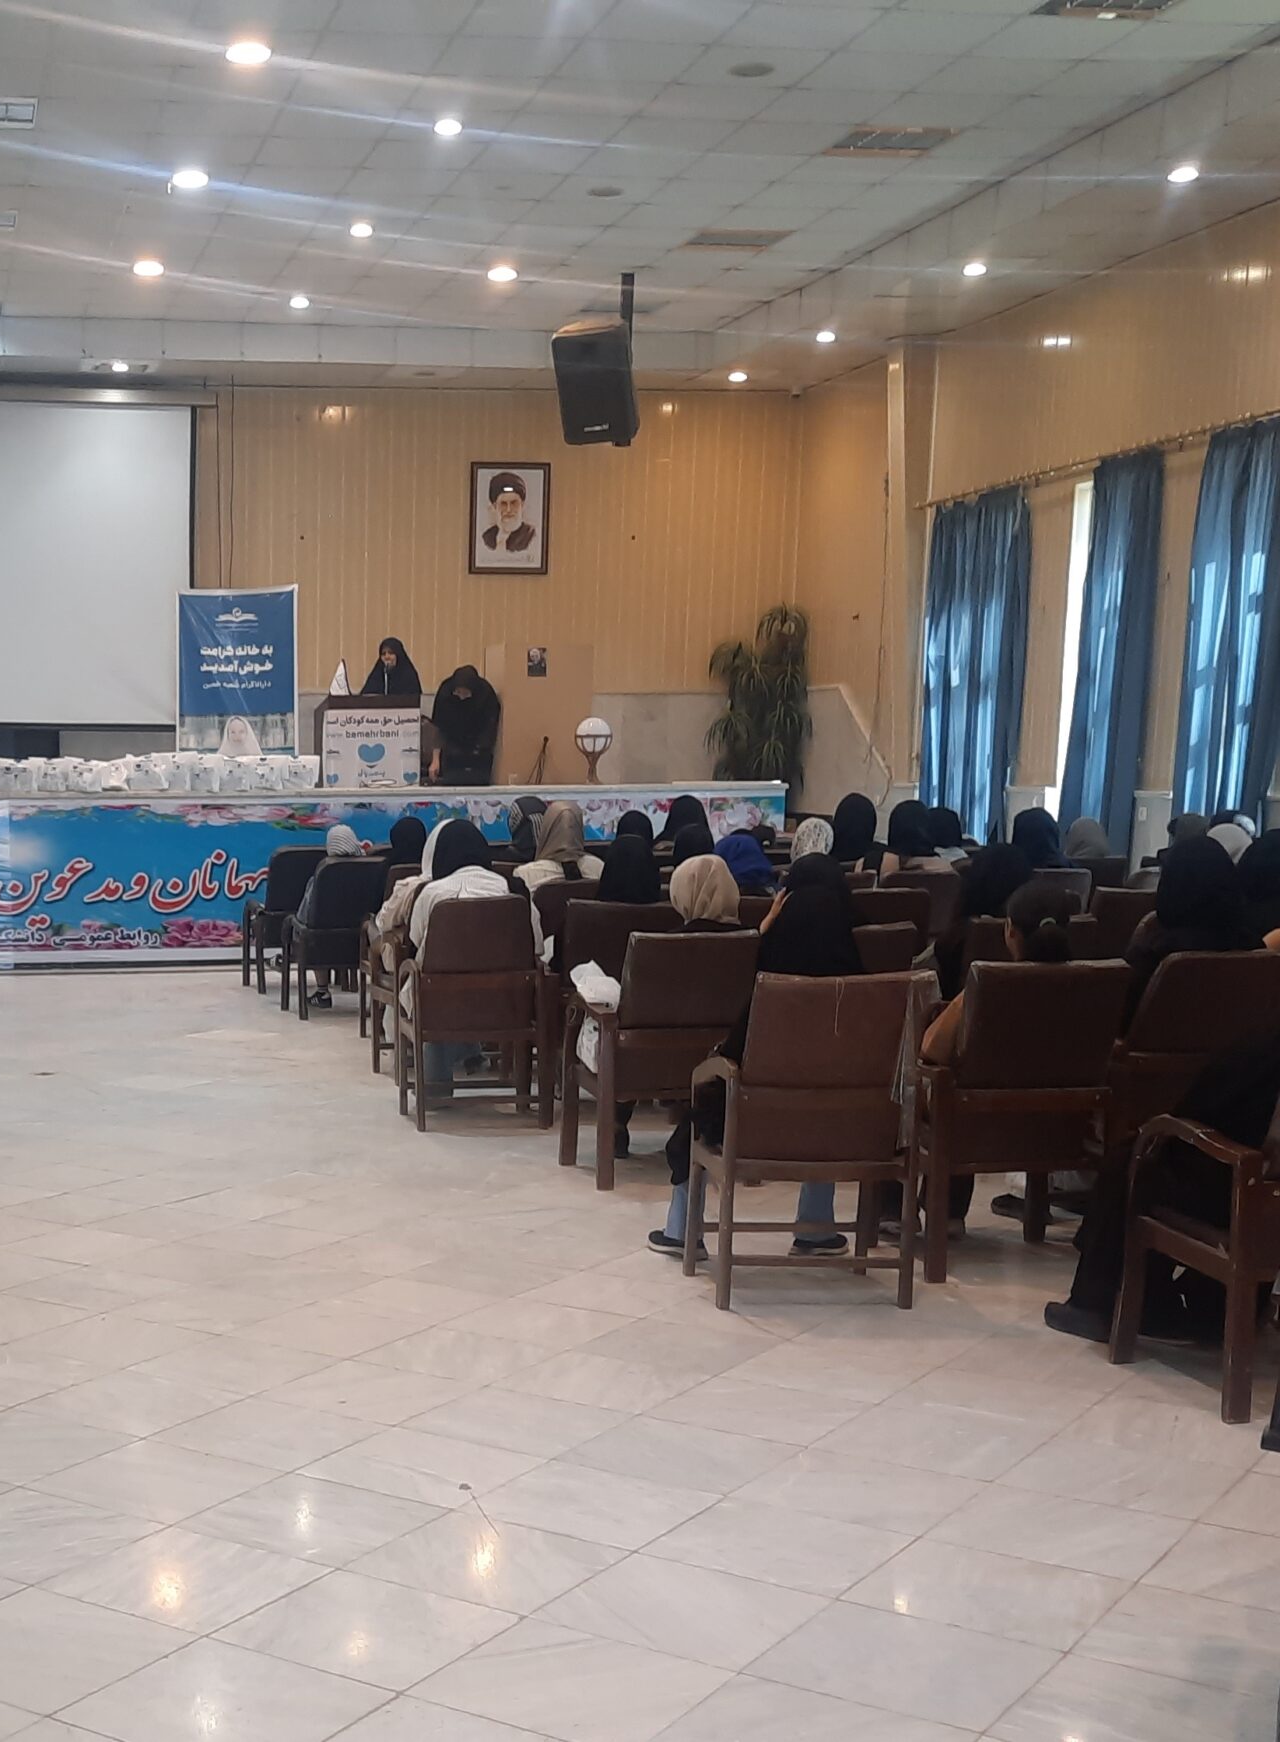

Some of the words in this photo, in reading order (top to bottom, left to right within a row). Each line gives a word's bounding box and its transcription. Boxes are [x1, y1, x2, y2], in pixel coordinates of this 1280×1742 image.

[200, 645, 234, 659] کرامت
[235, 643, 260, 656] خانه
[261, 644, 273, 657] به
[200, 660, 238, 674] آمدید
[239, 660, 273, 675] خوش
[51, 932, 114, 947] عمومی
[116, 927, 160, 946] روابط
